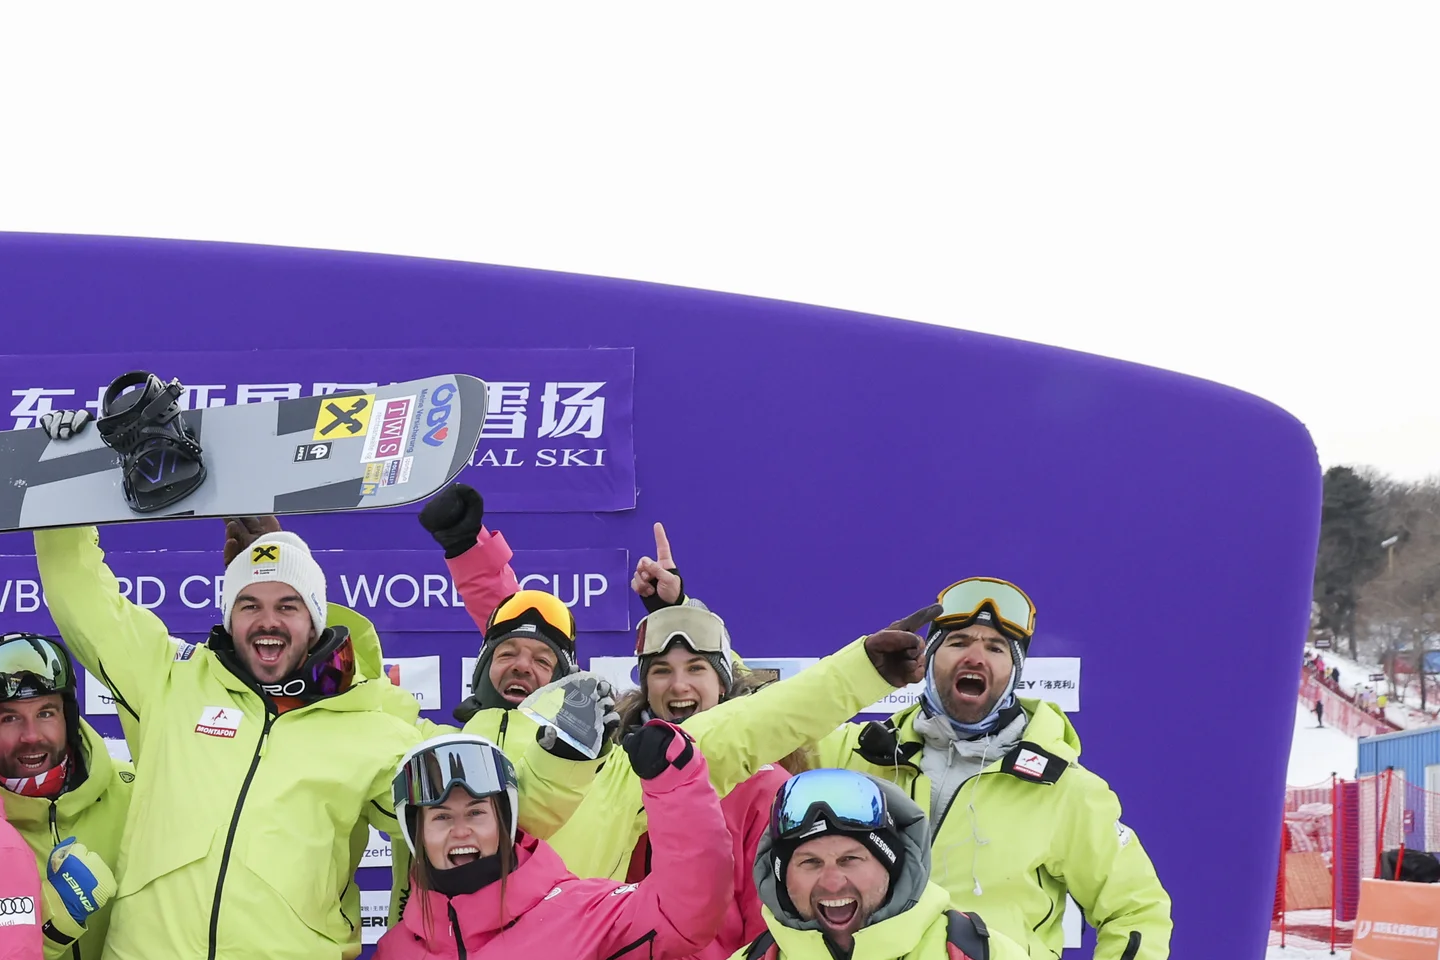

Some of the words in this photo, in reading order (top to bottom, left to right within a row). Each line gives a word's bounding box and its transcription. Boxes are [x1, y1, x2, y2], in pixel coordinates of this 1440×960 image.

[535, 448, 607, 467] SKI
[340, 574, 465, 608] WORL
[197, 725, 235, 738] MONTAFON
